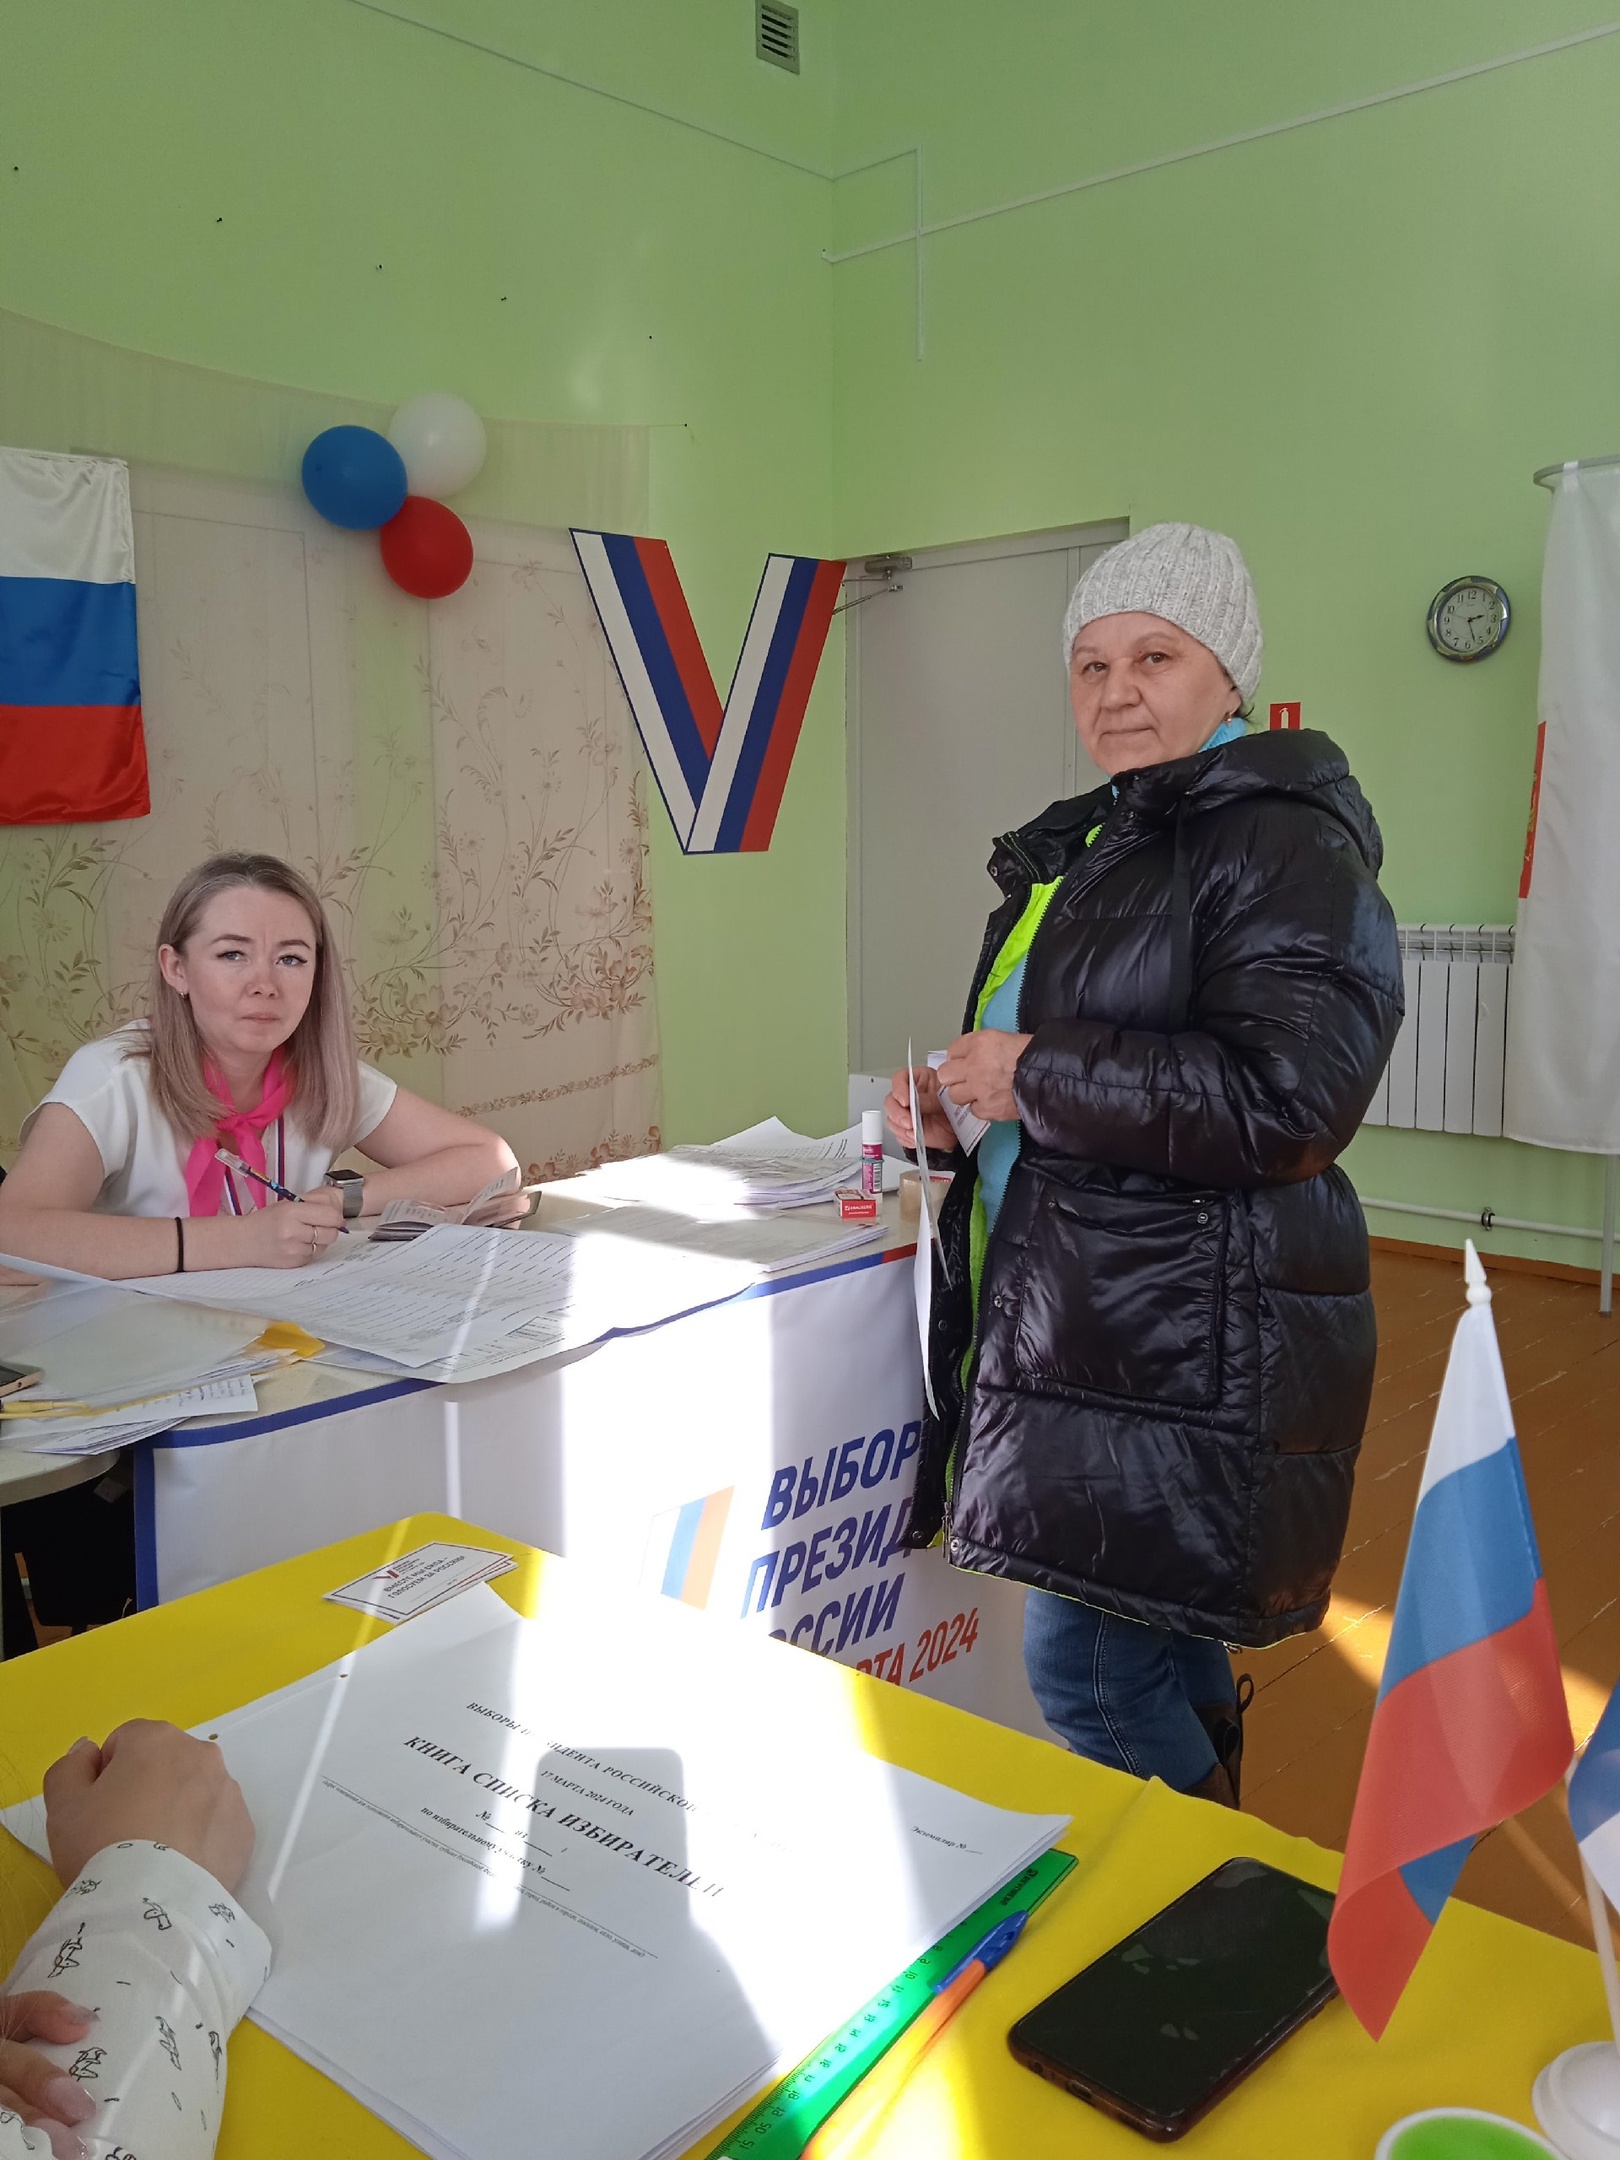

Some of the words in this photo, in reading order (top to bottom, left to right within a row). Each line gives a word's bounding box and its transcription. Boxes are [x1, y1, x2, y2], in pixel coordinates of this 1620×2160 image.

[761, 1420, 922, 1530] ВЫБОР
[740, 1497, 914, 1619] ПРЕЗИД
[909, 1607, 979, 1682] 2024
[467, 1702, 521, 1730] ВЫБОРЫ
[403, 1736, 472, 1775] КНИГА
[421, 1807, 433, 1816] по
[550, 1775, 586, 1795] МАРТА
[605, 1798, 634, 1817] ГОДА
